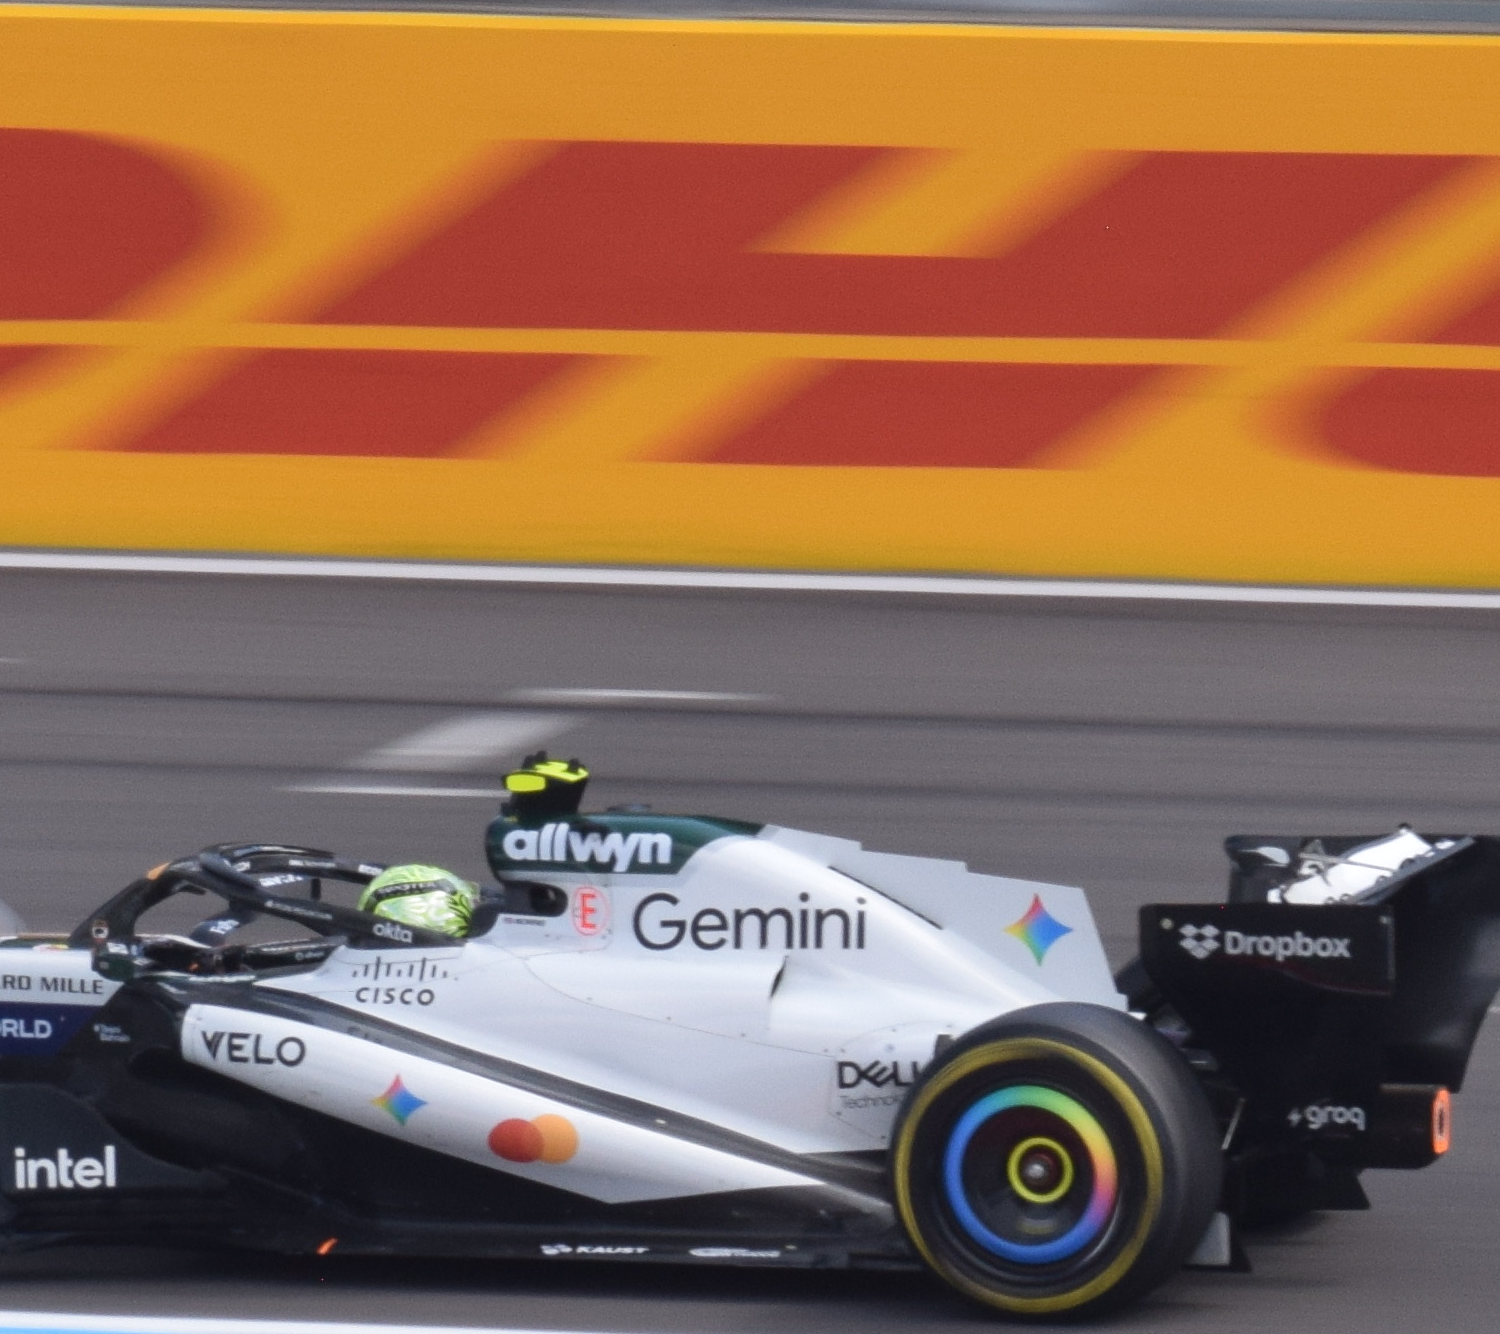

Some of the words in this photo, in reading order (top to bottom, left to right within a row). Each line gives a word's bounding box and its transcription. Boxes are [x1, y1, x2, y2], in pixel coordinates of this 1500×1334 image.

[503, 823, 672, 872] allwyn
[372, 922, 413, 943] okta
[633, 892, 866, 951] Gemini
[1223, 930, 1351, 962] Dropbox
[40, 976, 104, 995] MILLE
[356, 987, 435, 1006] CISCO
[201, 1030, 307, 1067] VELO
[1304, 1104, 1366, 1131] groq
[14, 1144, 117, 1189] intel
